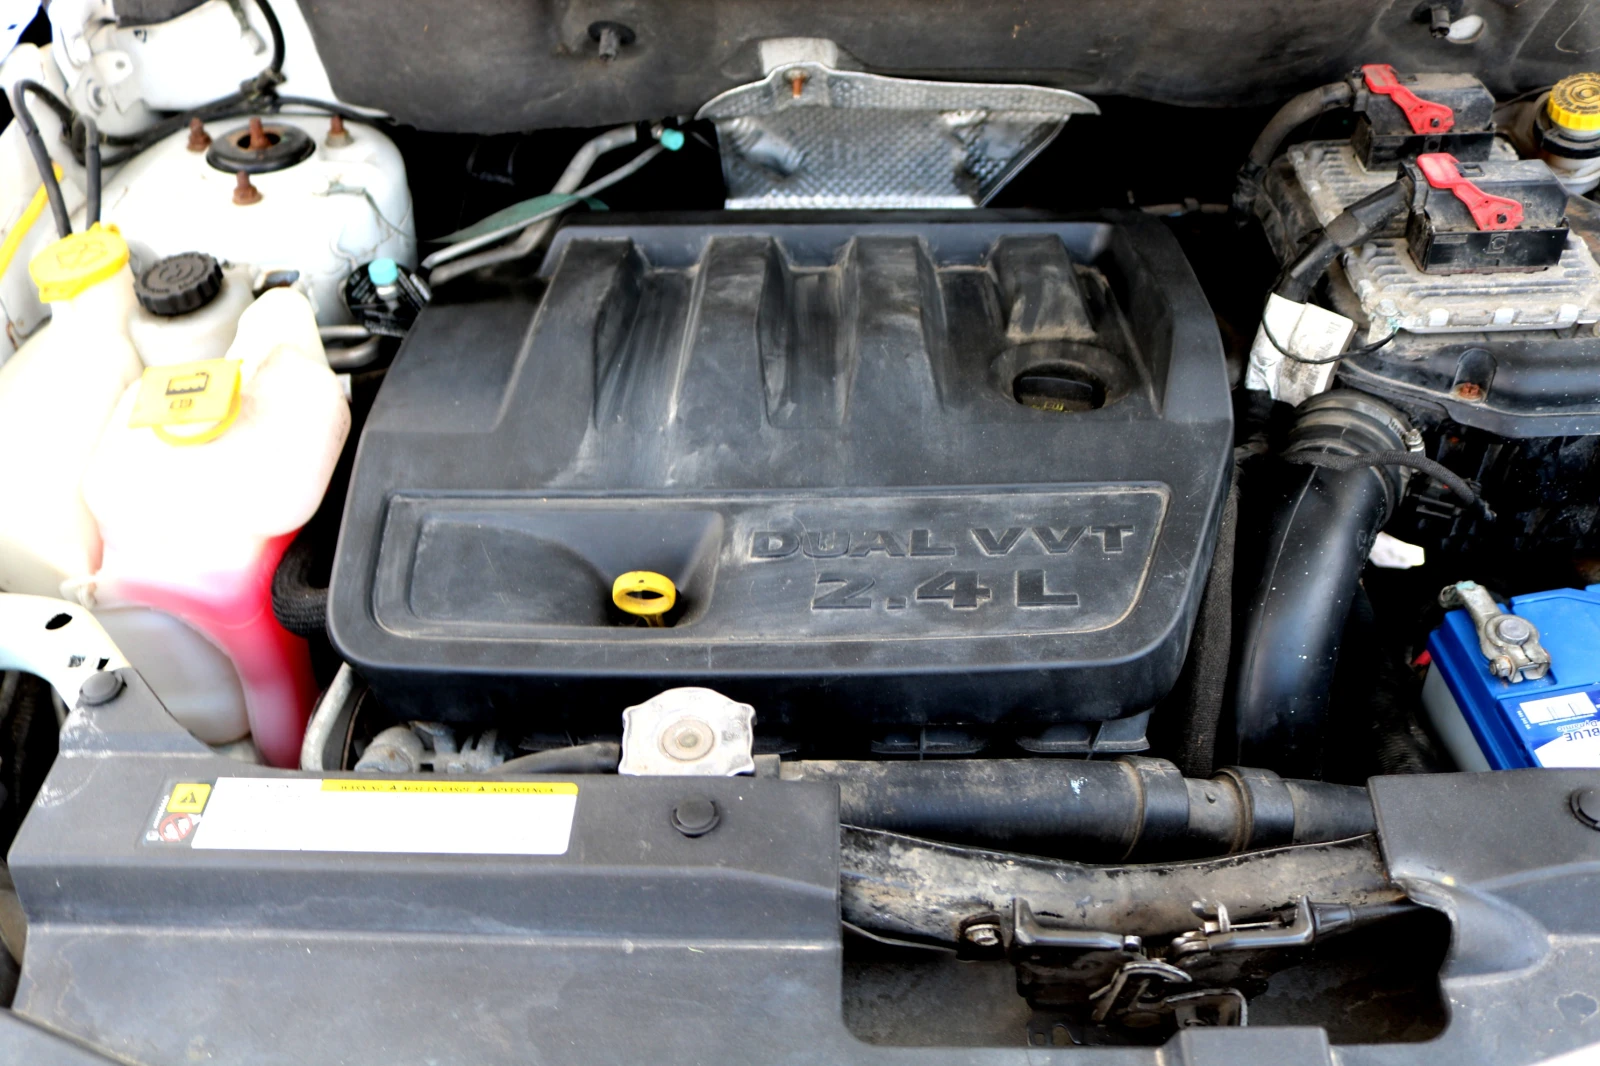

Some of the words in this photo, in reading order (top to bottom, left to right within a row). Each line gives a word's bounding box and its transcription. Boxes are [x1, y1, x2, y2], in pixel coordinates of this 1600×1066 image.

[750, 530, 956, 559] DUAL
[970, 524, 1135, 555] VVT
[1564, 727, 1600, 742] BLUE
